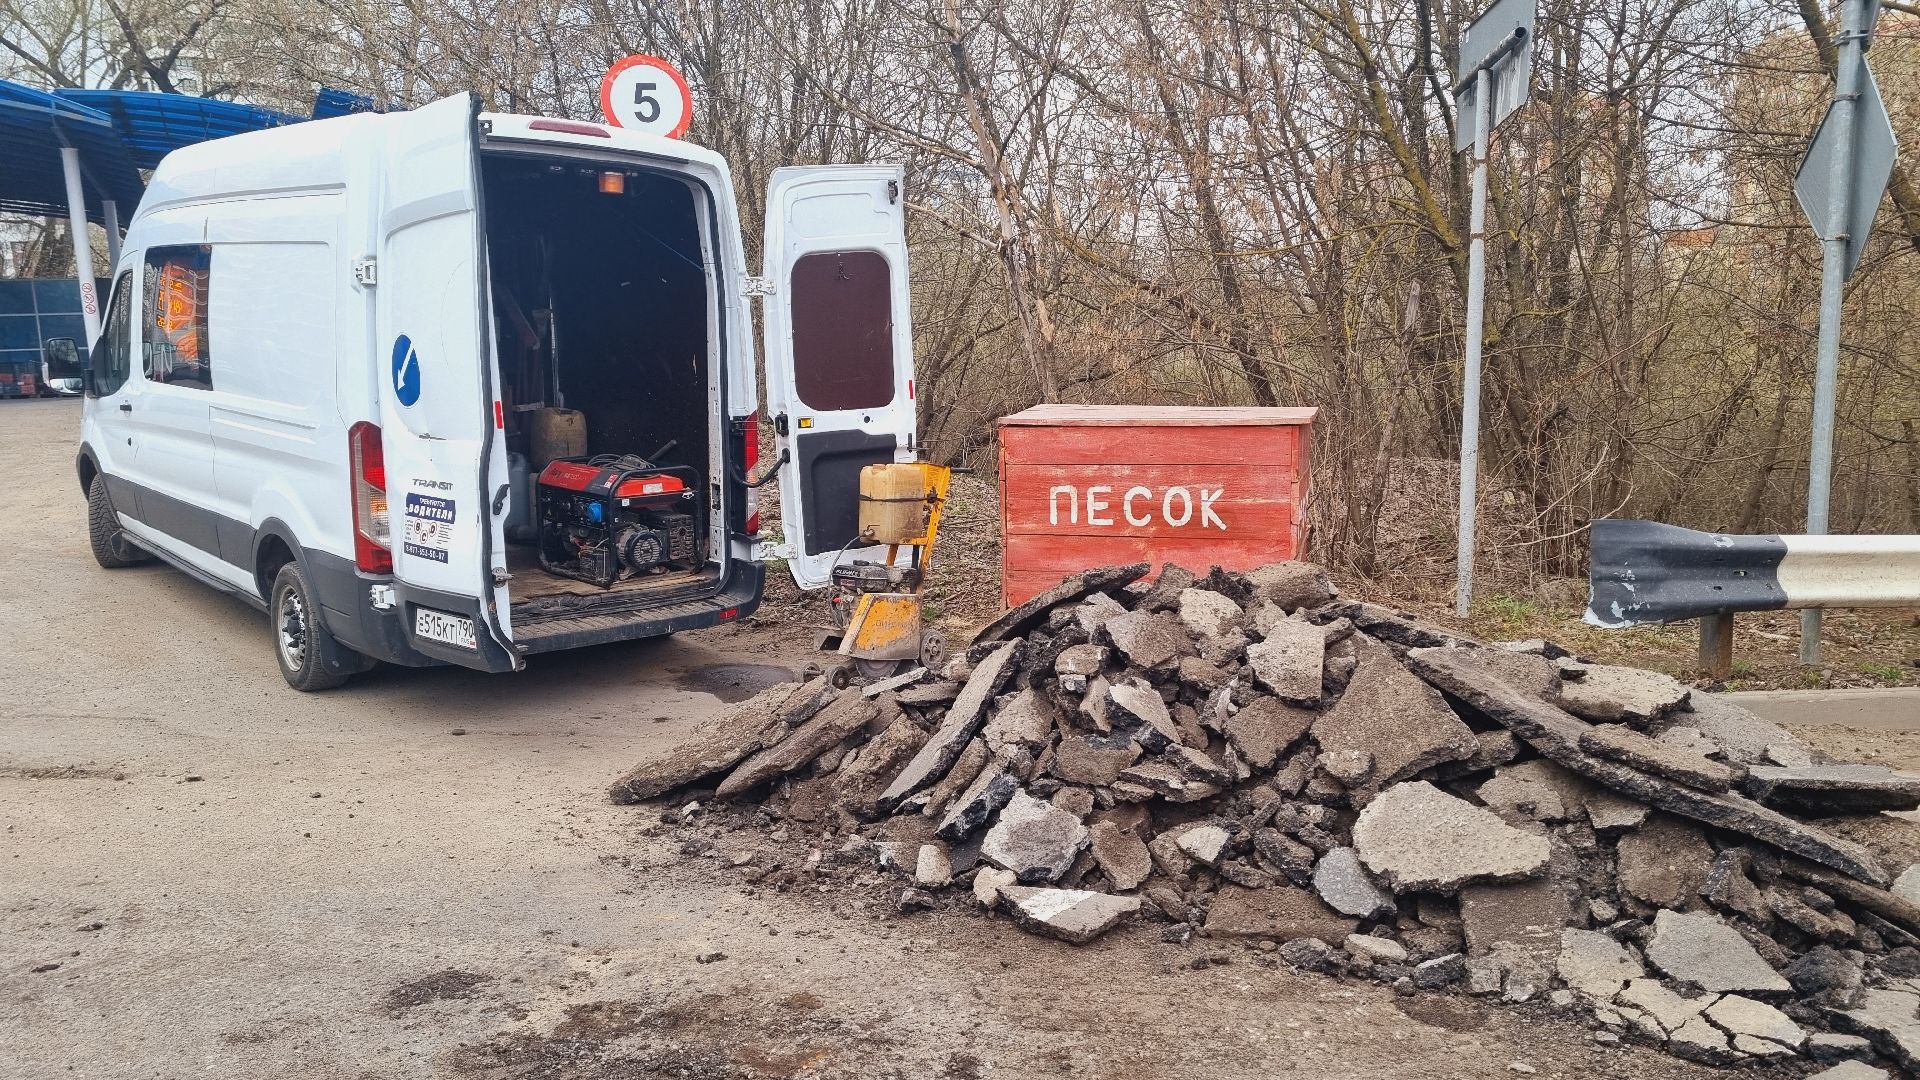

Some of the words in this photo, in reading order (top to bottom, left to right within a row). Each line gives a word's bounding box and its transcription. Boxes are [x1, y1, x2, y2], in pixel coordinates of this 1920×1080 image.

[634, 82, 661, 123] 5
[412, 478, 454, 491] TRANSIT
[408, 503, 453, 520] ВОДИТЕЛИ
[1049, 484, 1227, 531] ПЕСОК
[457, 619, 474, 638] 790
